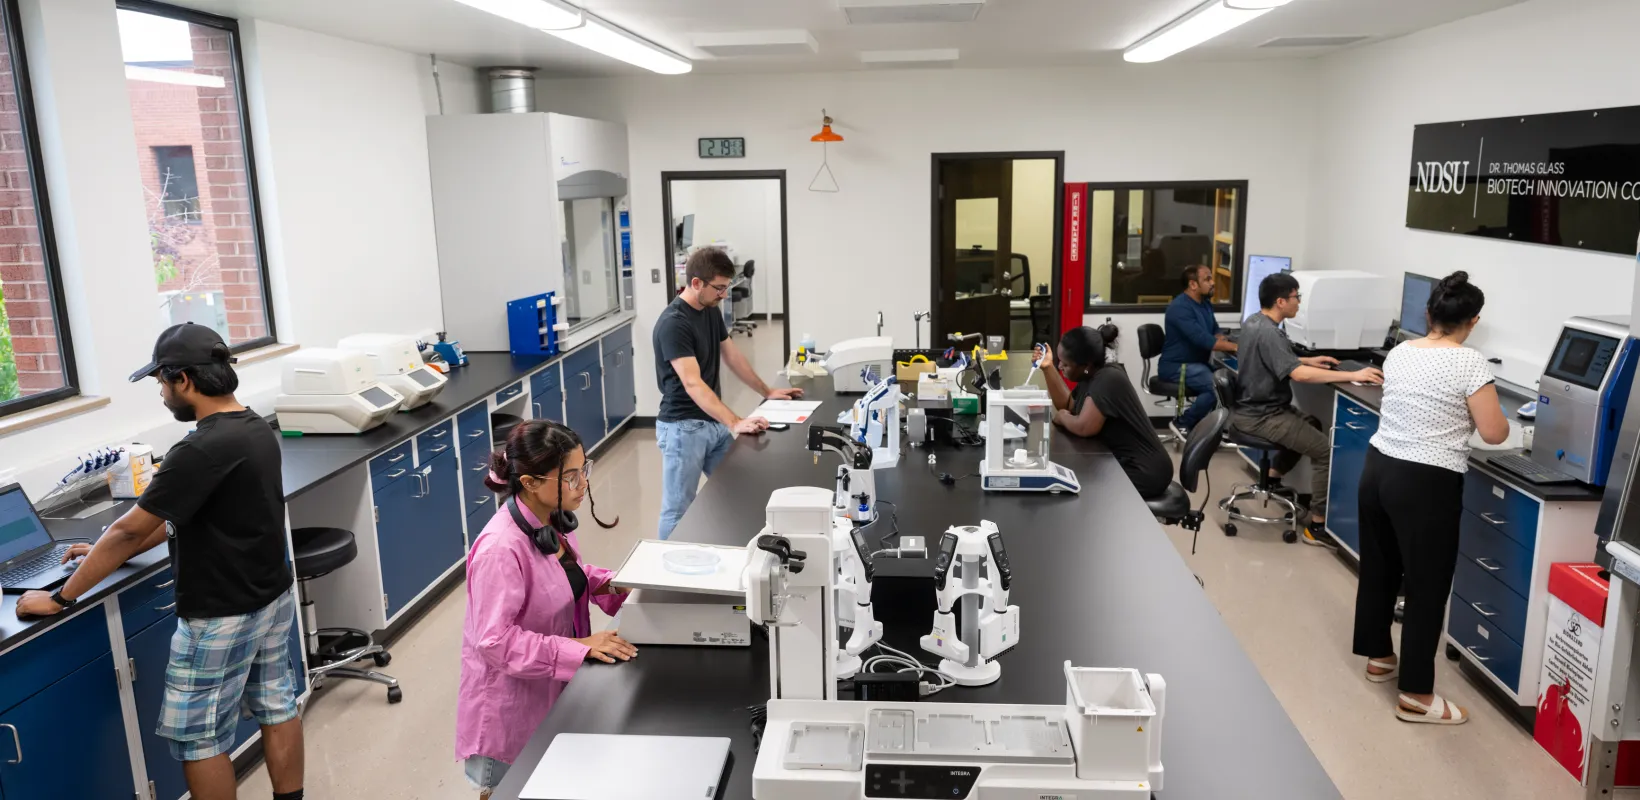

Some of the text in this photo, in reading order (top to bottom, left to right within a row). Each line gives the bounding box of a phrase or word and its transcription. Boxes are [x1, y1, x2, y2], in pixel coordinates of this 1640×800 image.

[1414, 161, 1470, 194] NDSU
[1489, 162, 1565, 175] DR. THOMAS GLASS
[1487, 178, 1534, 195] BIOTECH
[1536, 179, 1618, 200] INNOVATION
